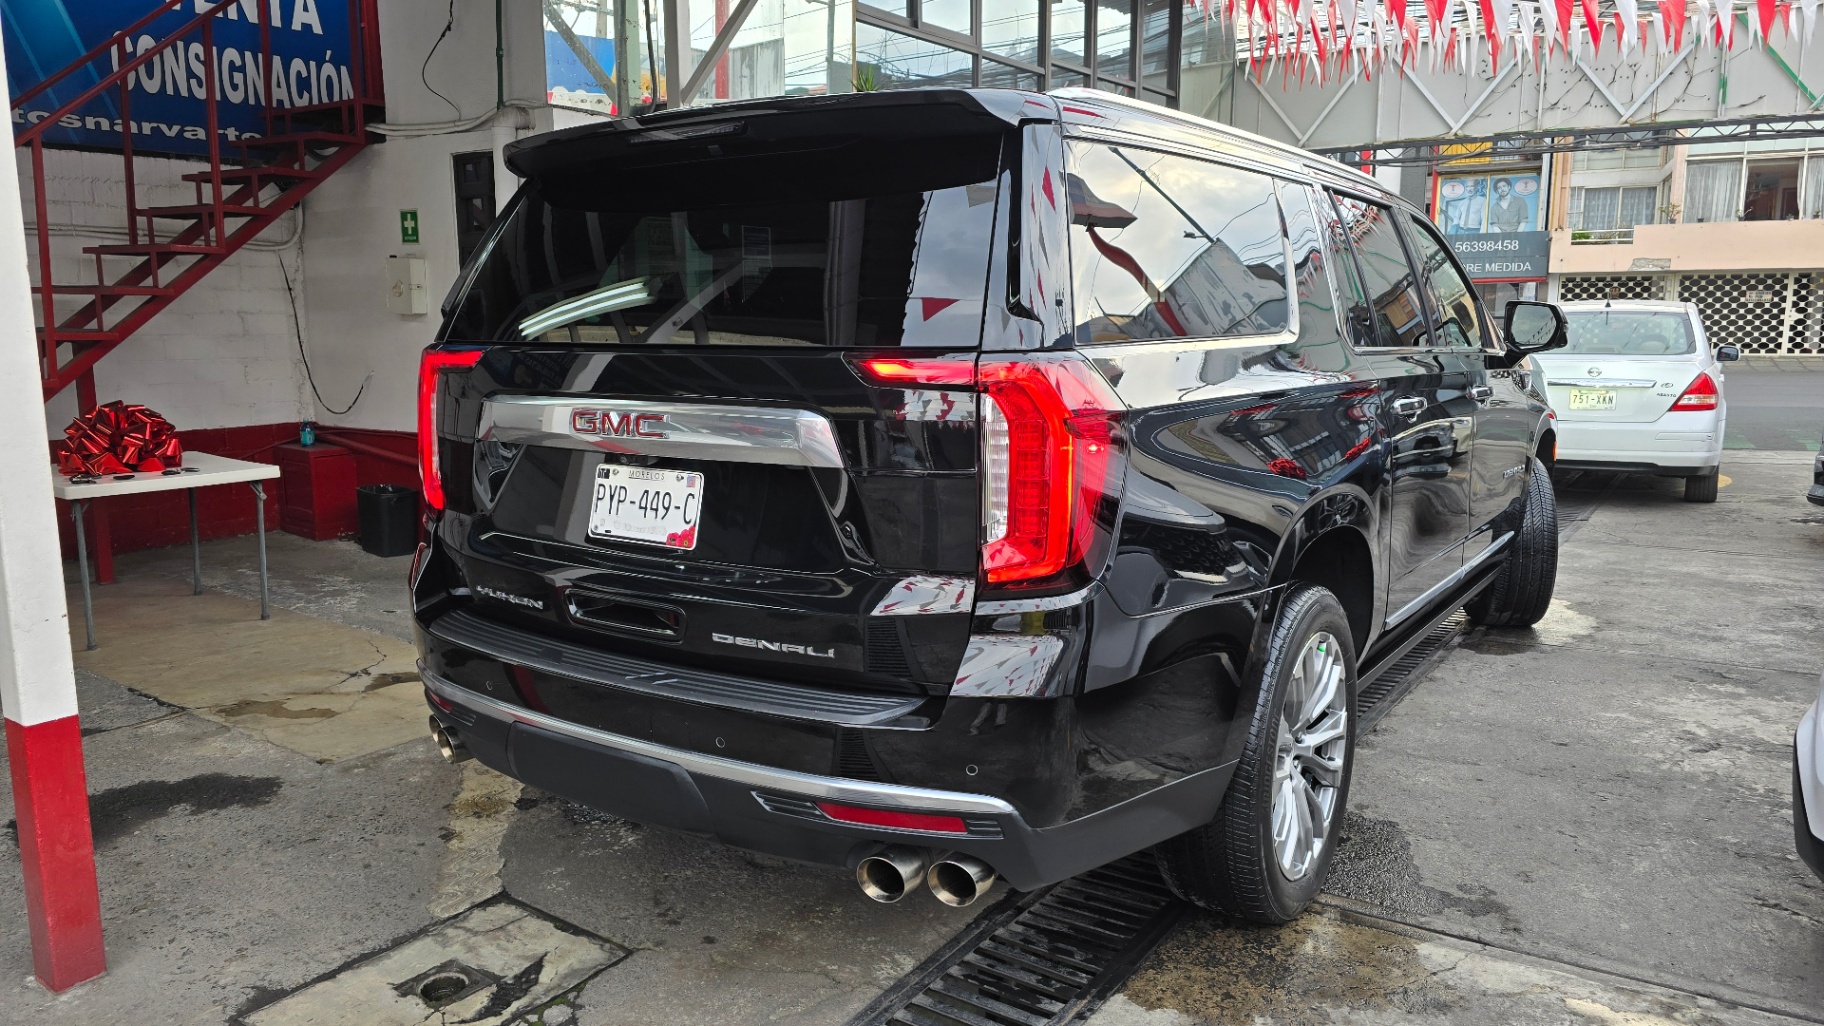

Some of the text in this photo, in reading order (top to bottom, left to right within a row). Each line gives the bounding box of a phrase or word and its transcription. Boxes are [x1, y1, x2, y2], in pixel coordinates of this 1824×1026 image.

[110, 30, 355, 109] CONSIGNACIÓN
[1454, 239, 1519, 253] 56398458
[1463, 262, 1532, 273] RE MEDIDA
[569, 408, 670, 439] GMC
[628, 470, 665, 480] MORELOS
[594, 483, 695, 525] PYP-449-C
[711, 632, 835, 659] DENALI
